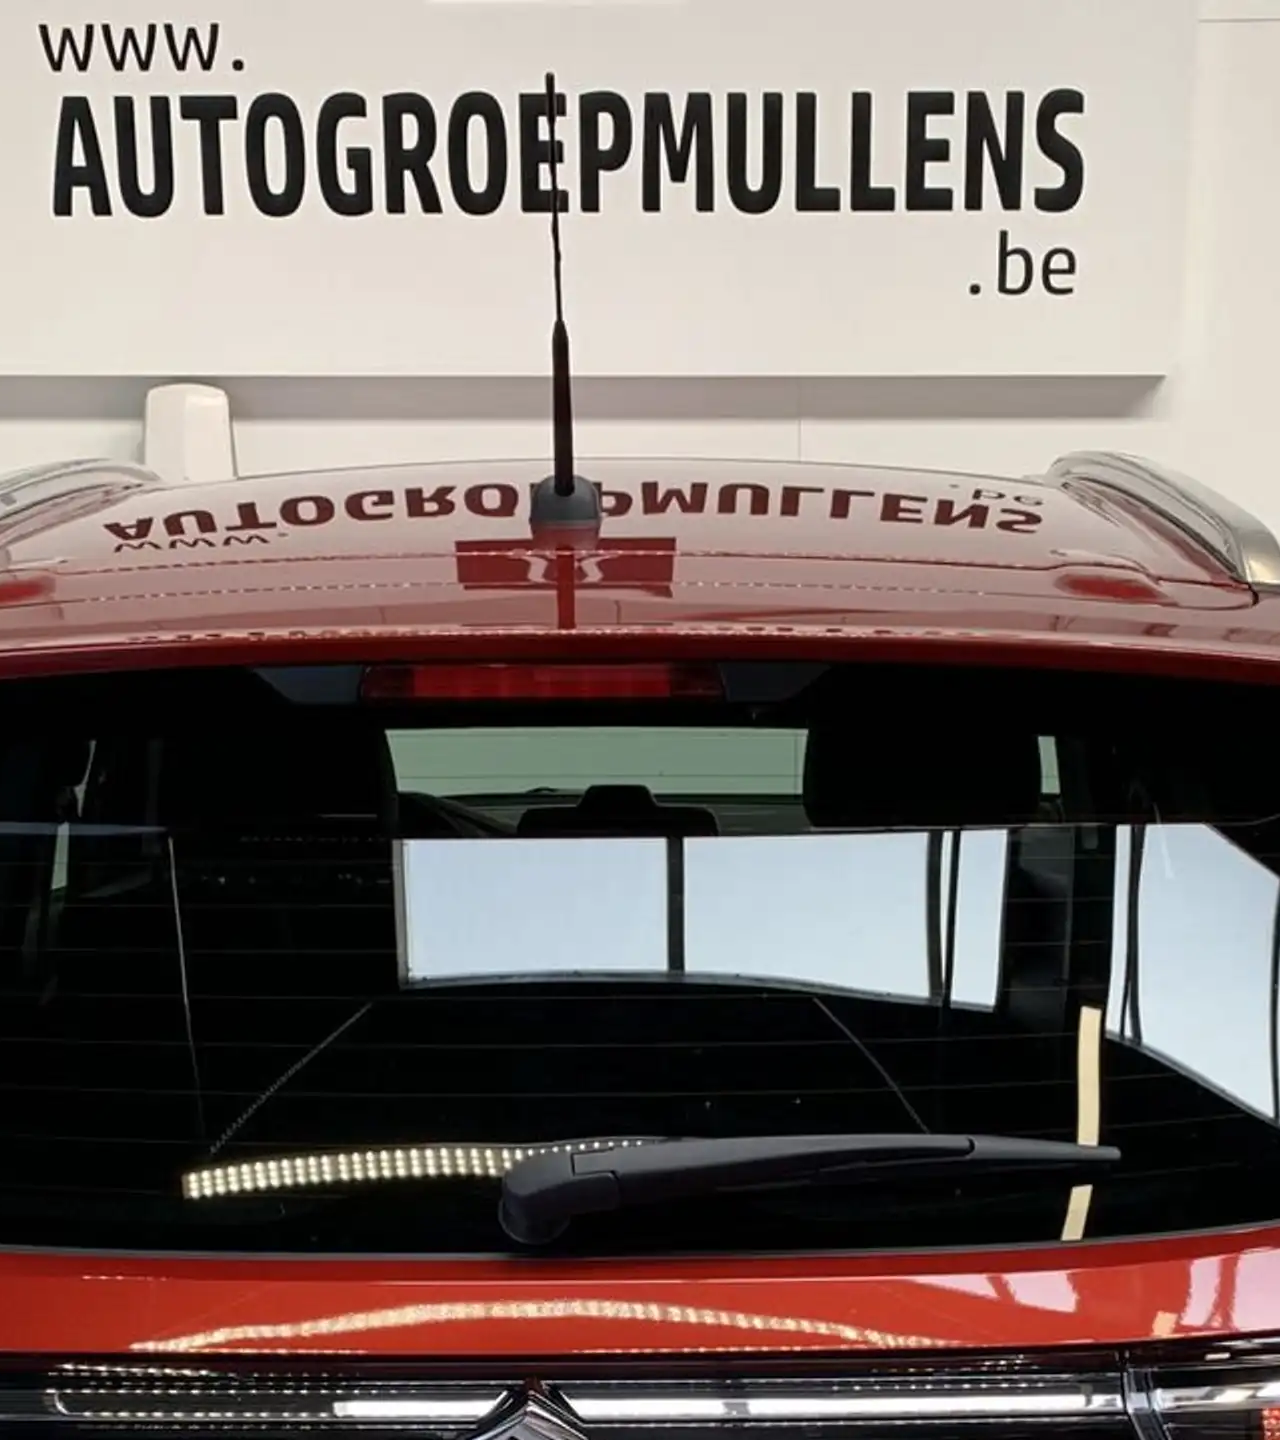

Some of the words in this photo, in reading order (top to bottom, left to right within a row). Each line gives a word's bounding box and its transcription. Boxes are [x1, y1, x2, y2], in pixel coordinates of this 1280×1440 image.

[37, 22, 244, 72] www.
[52, 89, 1086, 217] AUTOGROEPMULLENS
[969, 229, 1077, 295] .be
